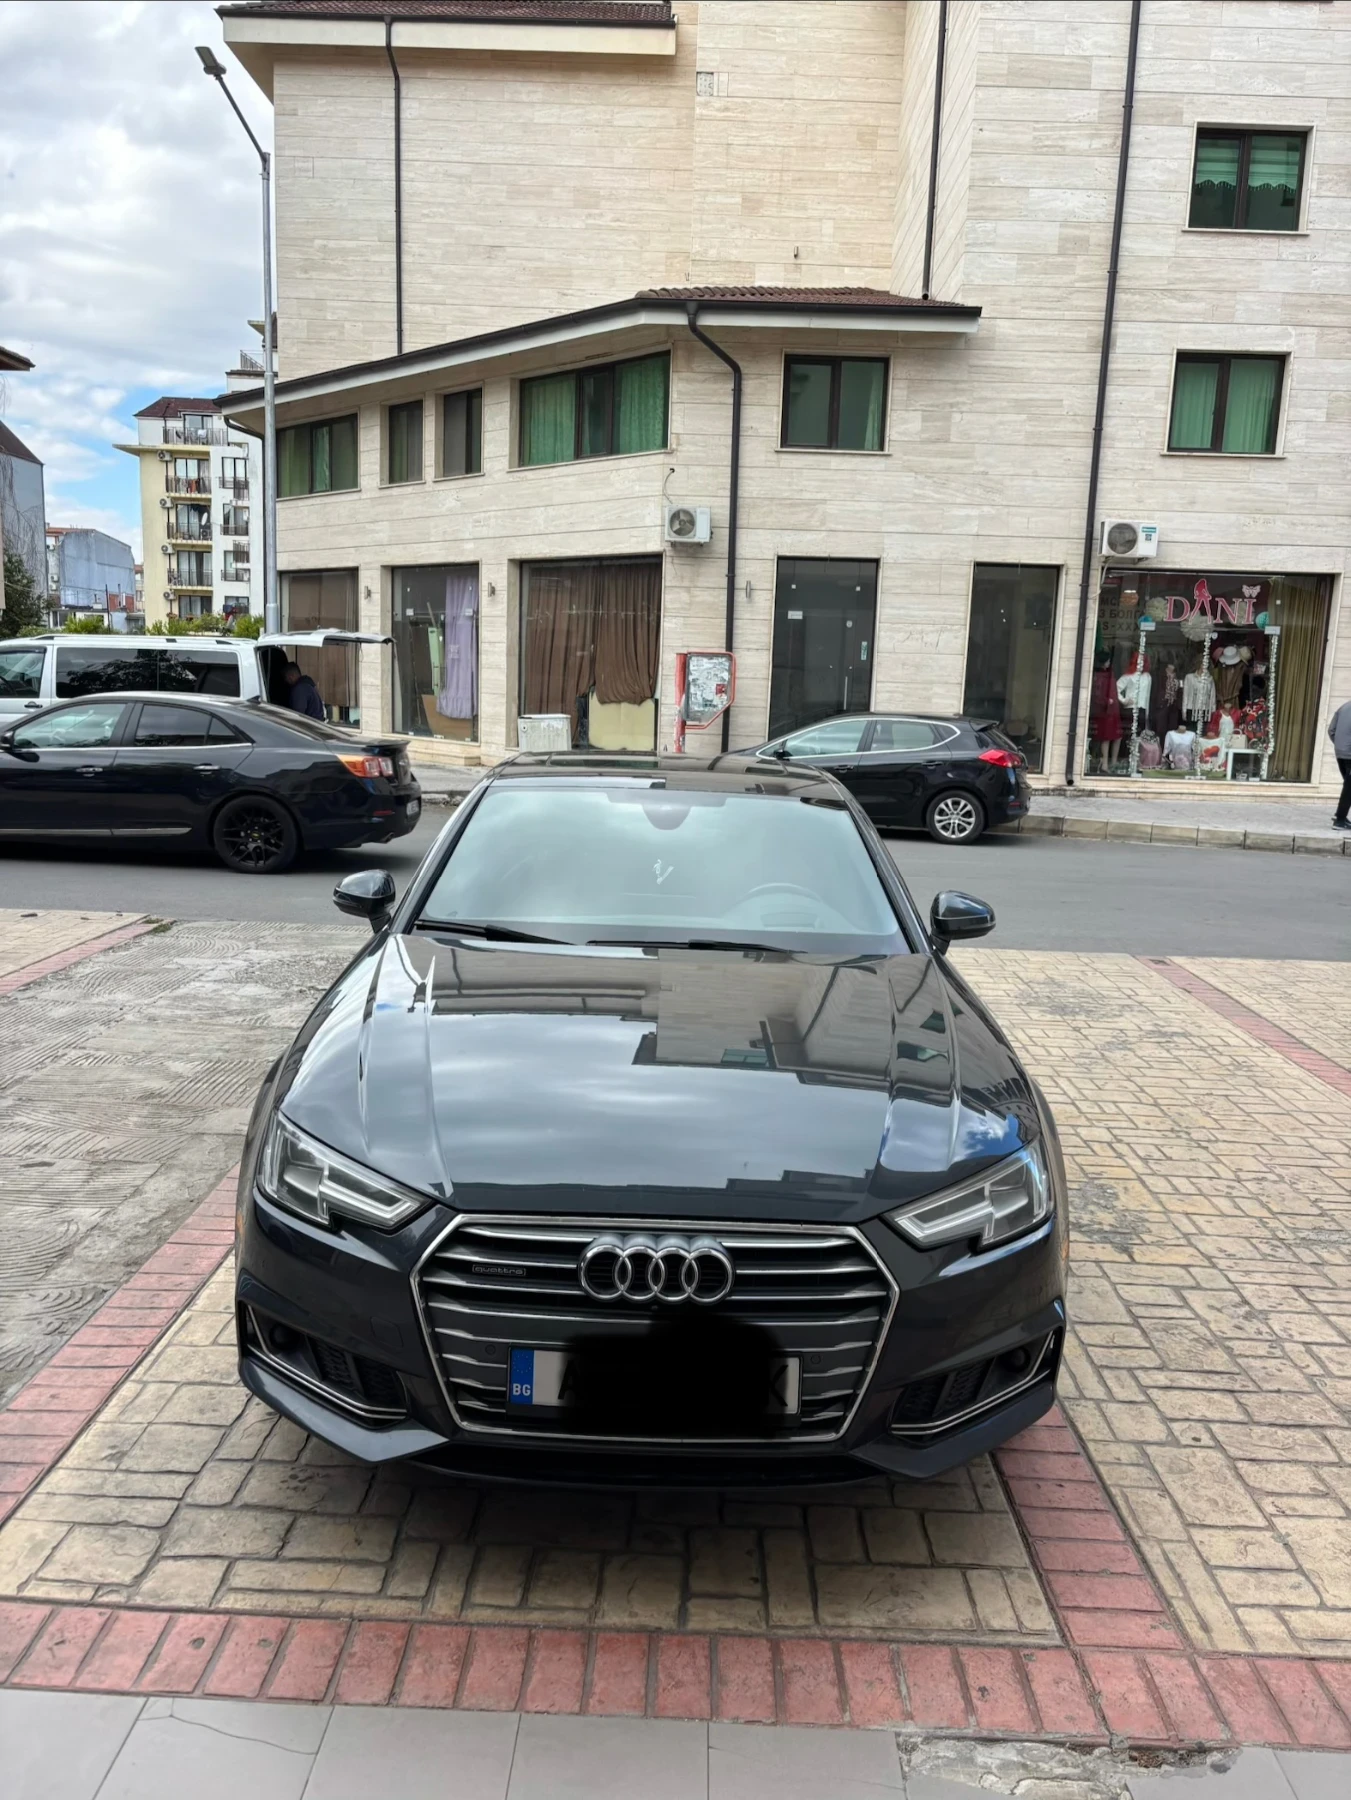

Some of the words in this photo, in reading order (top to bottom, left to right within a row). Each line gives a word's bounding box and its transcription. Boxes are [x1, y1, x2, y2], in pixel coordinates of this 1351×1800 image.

[1163, 578, 1257, 625] DANI
[474, 1266, 524, 1275] quattro
[512, 1383, 532, 1397] BG
